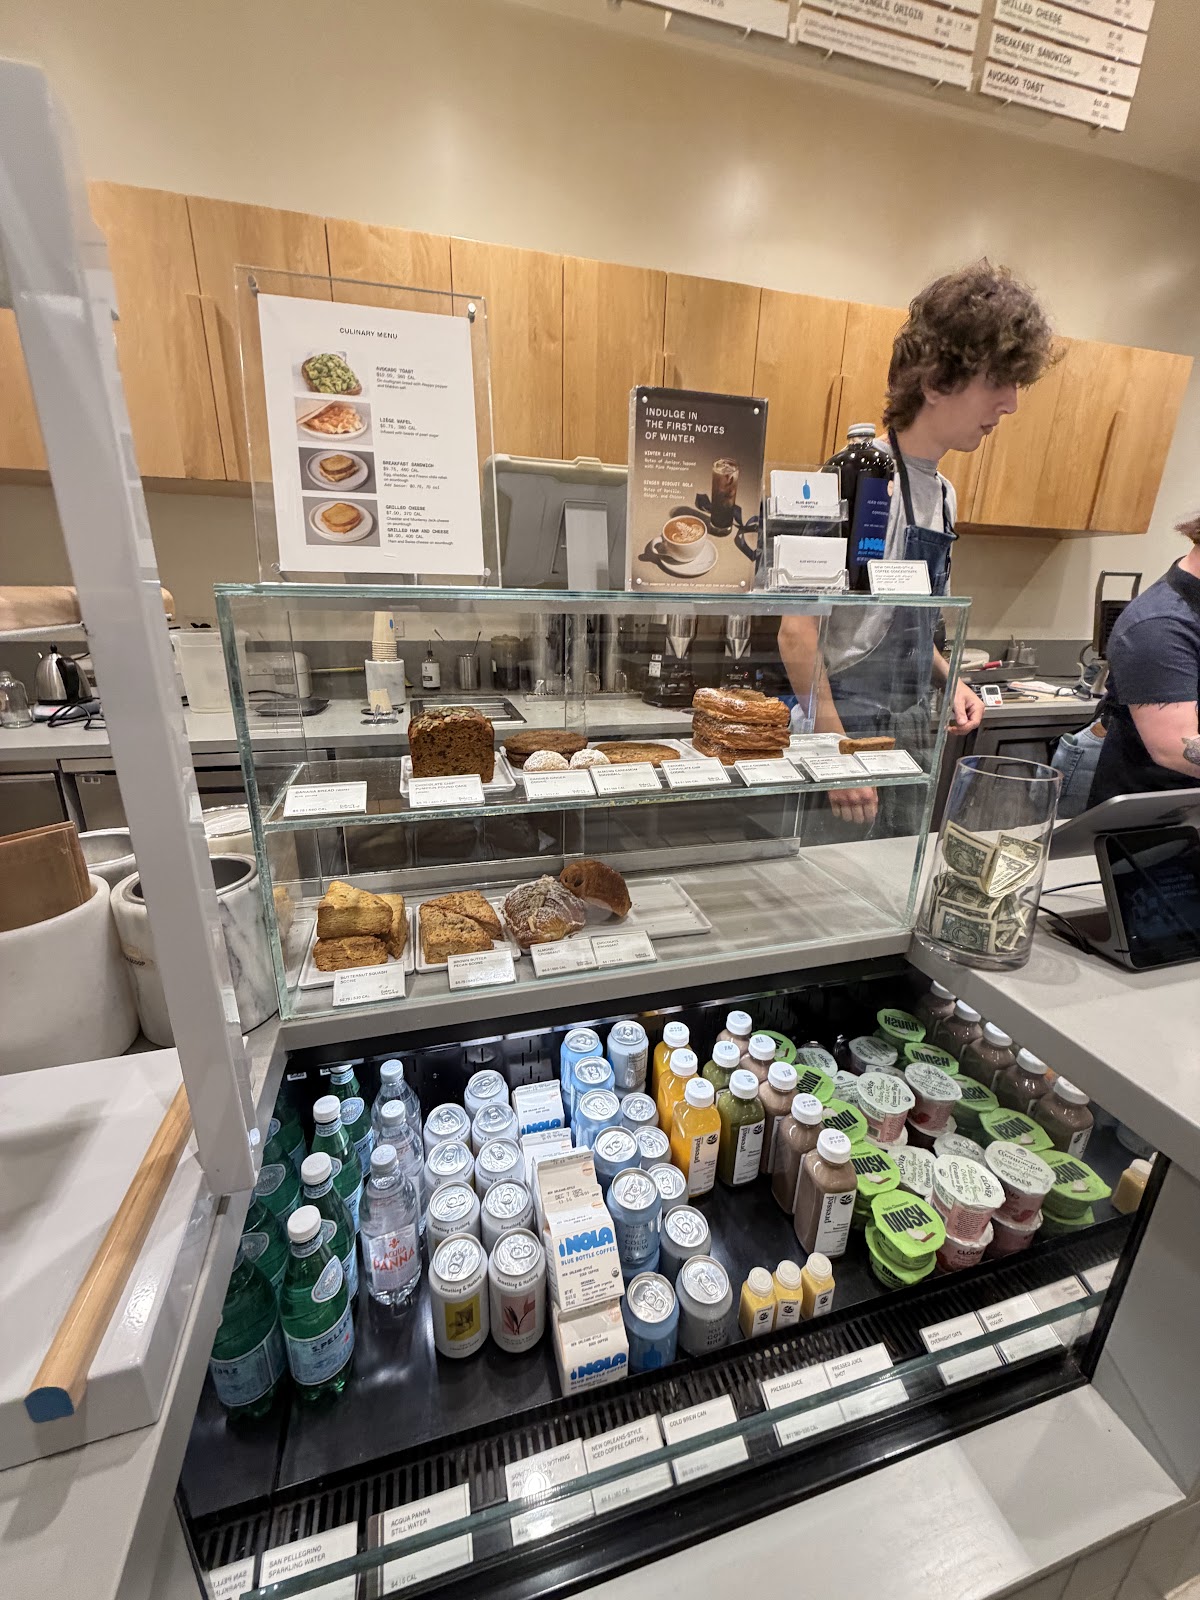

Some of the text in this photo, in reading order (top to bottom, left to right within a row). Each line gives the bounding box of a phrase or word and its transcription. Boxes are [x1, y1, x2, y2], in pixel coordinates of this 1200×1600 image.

[1036, 8, 1062, 25] CHEESE
[995, 33, 1034, 53] BREAKFAST
[1037, 46, 1073, 66] SANDWICH
[987, 69, 1045, 92] AVOCADO TOAST
[340, 328, 397, 339] CULINARY MENU
[646, 408, 697, 420] INDULGE IN
[646, 420, 724, 434] THE FIRST NOTES
[660, 433, 695, 443] WINTER
[740, 1127, 748, 1152] pressed
[981, 1175, 992, 1198] CLOVER
[824, 1196, 834, 1224] pressed
[881, 1204, 933, 1233] MUSH
[565, 1227, 614, 1255] NOLA
[373, 1247, 414, 1271] PANNA
[384, 1246, 406, 1259] ACQUA
[561, 1246, 616, 1266] BLUE BOTTLE COFFEE
[440, 1285, 461, 1293] Something
[497, 1277, 517, 1289] Something
[578, 1353, 626, 1378] NOLA
[832, 1358, 862, 1371] PRESSED JUICE
[771, 1379, 803, 1393] PRESSED JUICE
[670, 1419, 682, 1427] COLD
[683, 1414, 696, 1424] BREW
[604, 1428, 642, 1446] ORLEANS-STYLE
[593, 1436, 644, 1459] ICED COFFEE CARTON
[391, 1508, 430, 1527] ACQUA PANNA
[391, 1518, 427, 1537] STILL WATER
[268, 1553, 325, 1578] SPARKLING WATER
[269, 1545, 322, 1568] SAN PELLEGRINO
[407, 1574, 417, 1582] CAL
